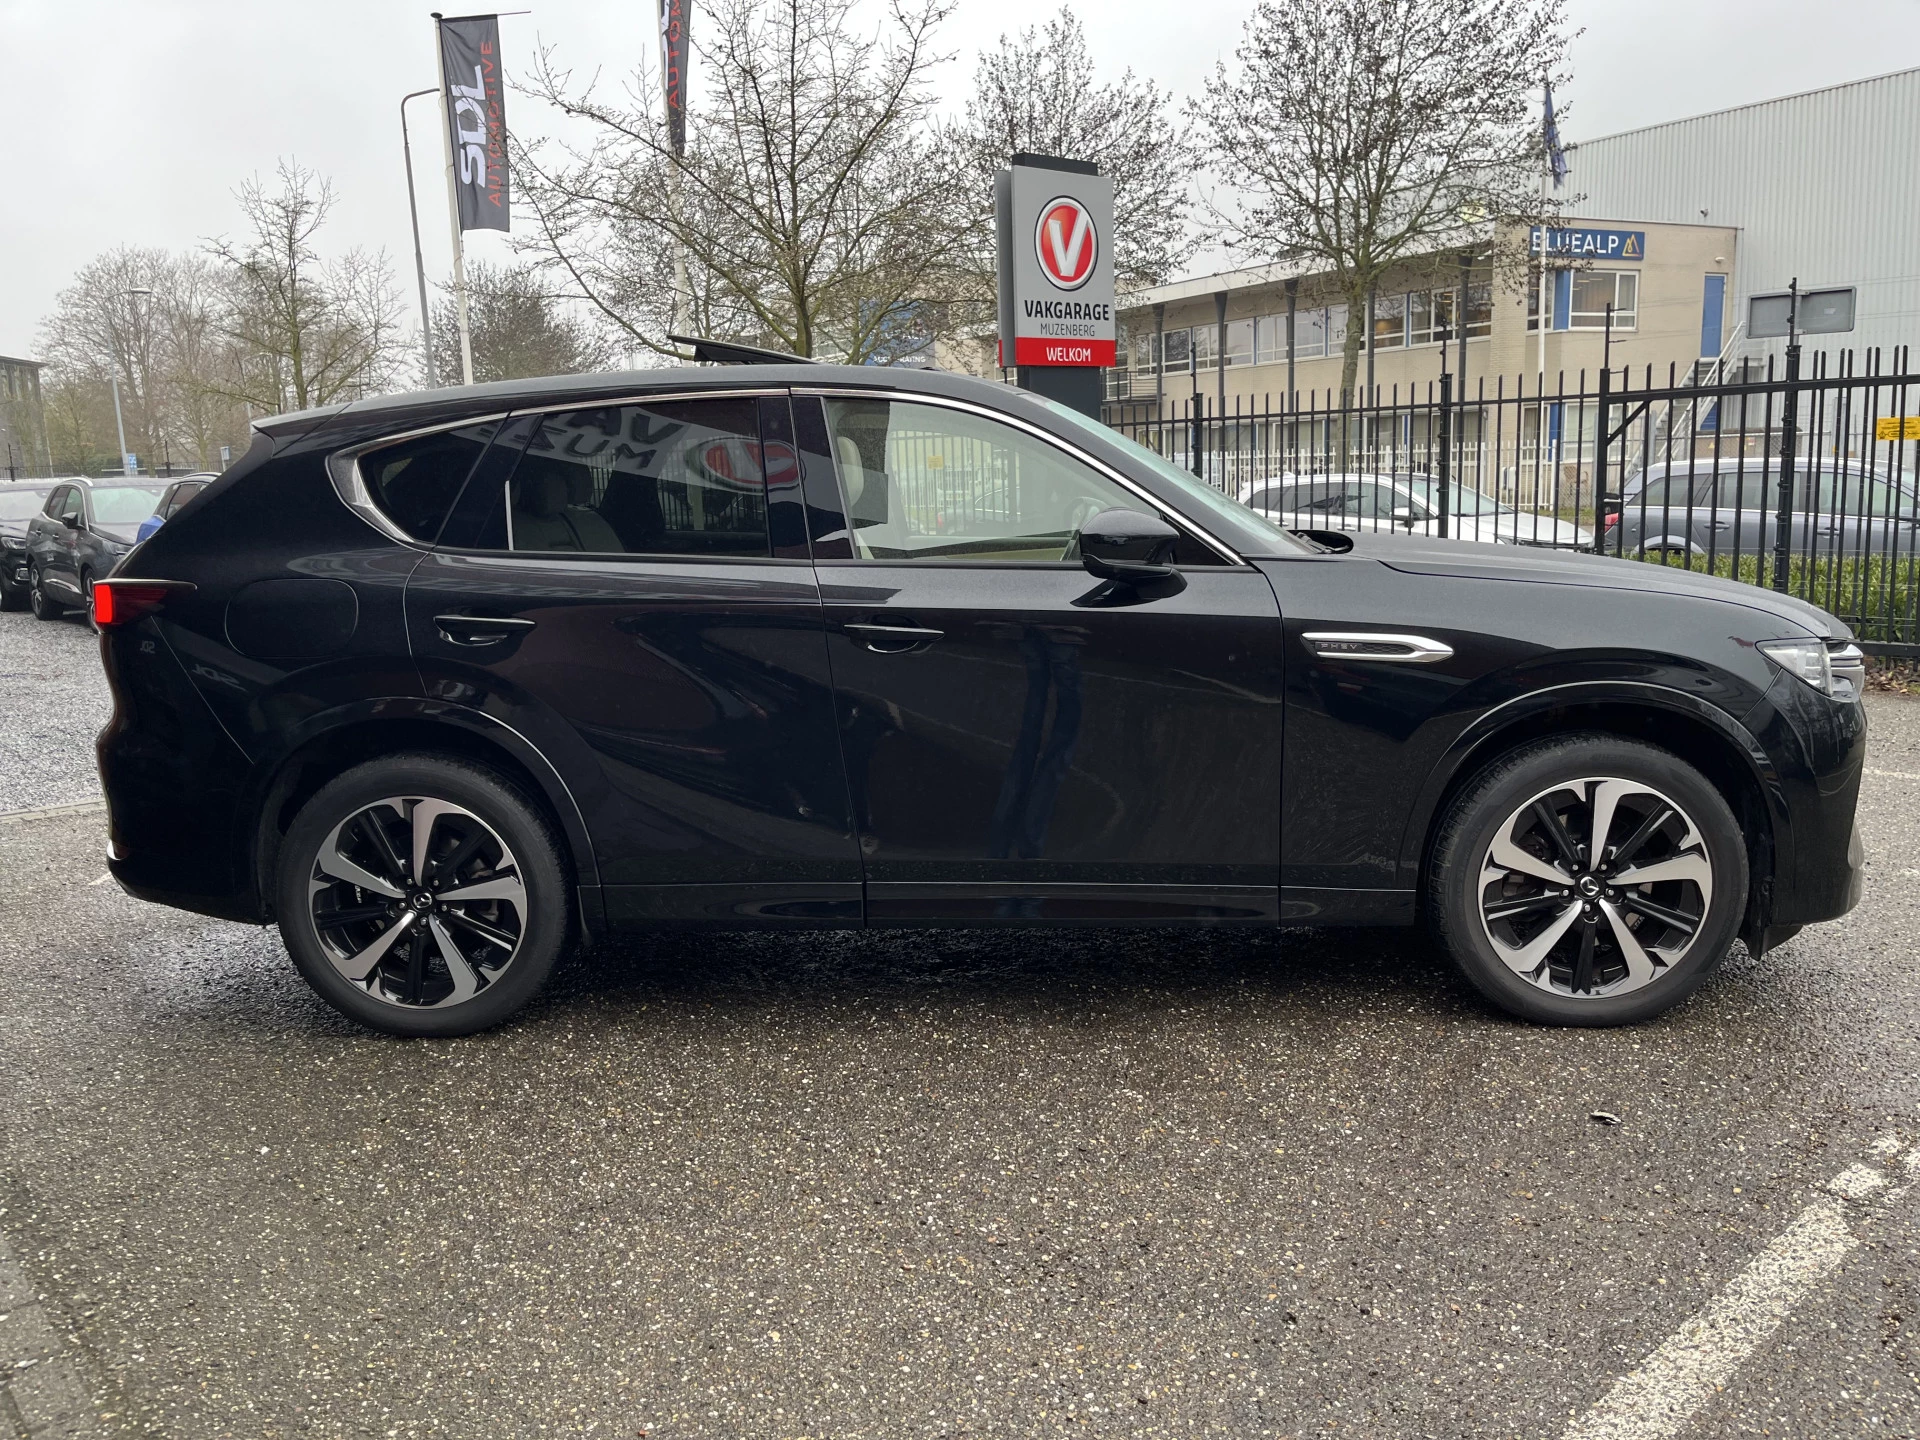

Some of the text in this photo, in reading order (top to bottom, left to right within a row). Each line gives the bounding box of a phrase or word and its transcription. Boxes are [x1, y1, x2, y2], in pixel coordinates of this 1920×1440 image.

[451, 65, 488, 188] SDL
[481, 41, 502, 208] AUTOMOTIVE
[1532, 231, 1619, 254] BLUEALP
[1024, 300, 1110, 321] VAKGARAGE
[1040, 323, 1096, 337] MUZENBERG
[1046, 347, 1092, 362] WELKOM
